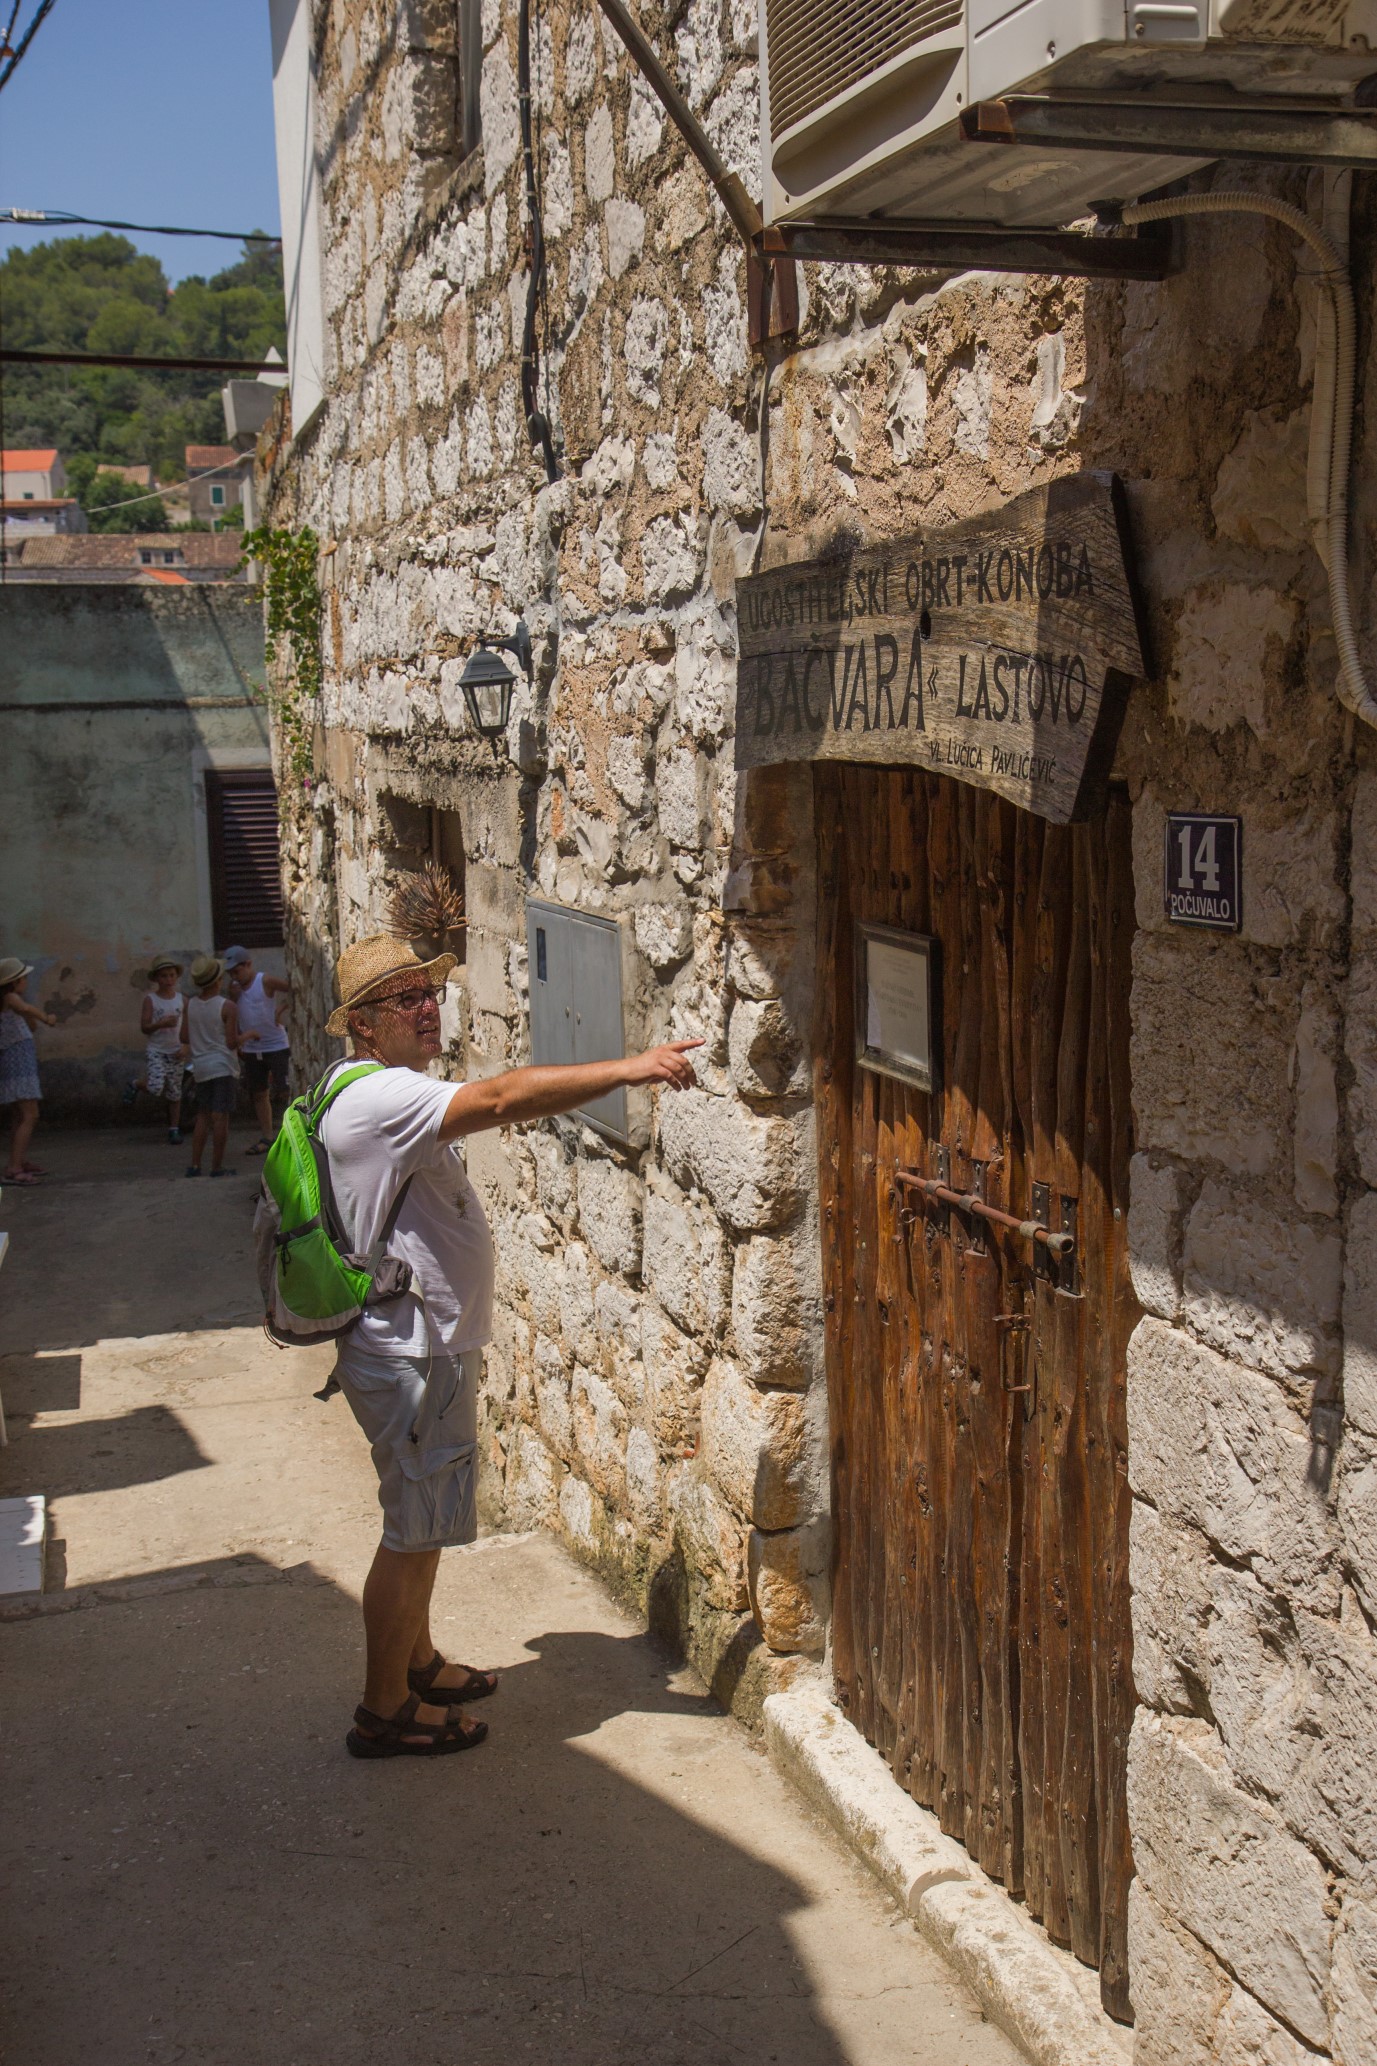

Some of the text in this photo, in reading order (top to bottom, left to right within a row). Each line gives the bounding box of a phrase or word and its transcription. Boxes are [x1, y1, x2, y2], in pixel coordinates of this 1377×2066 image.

[905, 541, 1094, 612] OBRT-KONOBA
[954, 652, 1087, 726] LASTOVO
[946, 737, 983, 771] LUČICA
[991, 744, 1057, 784] PAVLIČEVIĆ
[1177, 825, 1220, 891] 14
[1170, 891, 1231, 919] POČUVALO
